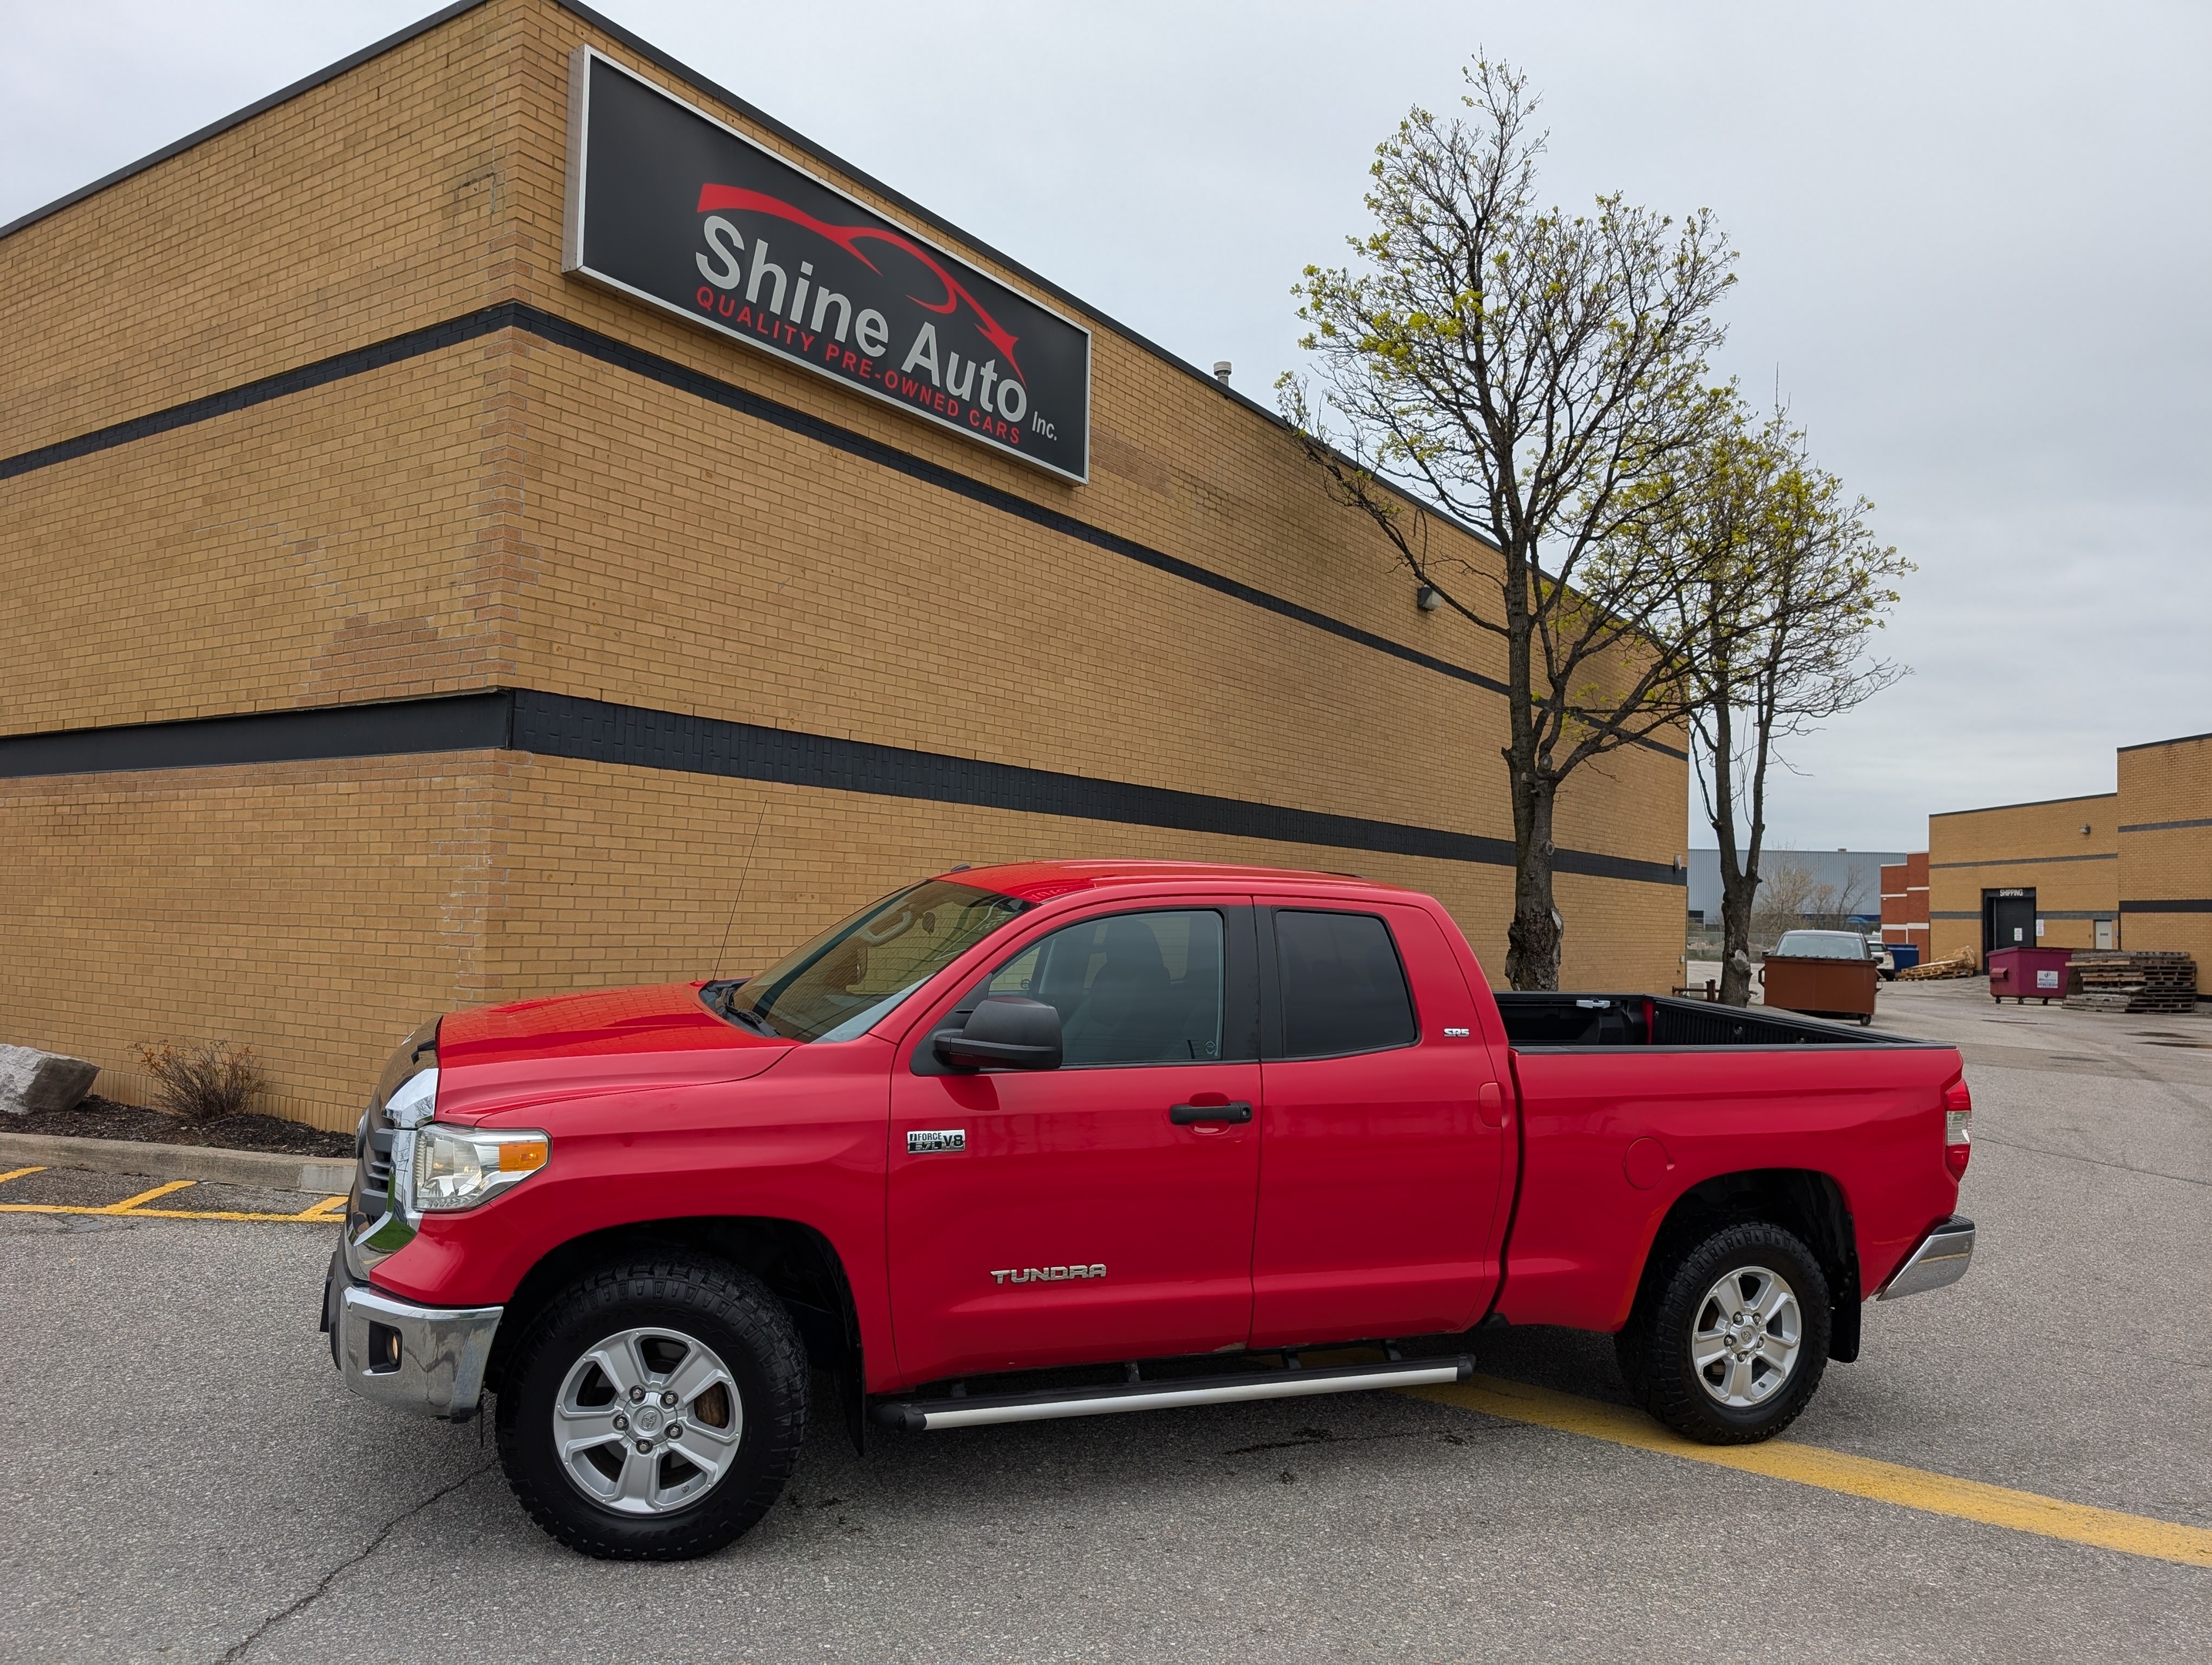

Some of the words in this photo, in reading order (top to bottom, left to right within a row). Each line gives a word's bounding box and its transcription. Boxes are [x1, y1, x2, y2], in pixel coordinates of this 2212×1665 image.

[695, 215, 889, 358] Shine
[901, 321, 1027, 422] Auto
[1032, 411, 1057, 441] Inc.
[696, 286, 815, 352] QUALITY
[825, 343, 959, 417] PRE-OWNED
[969, 409, 1020, 444] CARS
[1999, 889, 2023, 897] SHIPPING
[1444, 1028, 1470, 1037] SR5
[915, 1142, 939, 1150] 5.7L
[943, 1135, 964, 1148] V8
[991, 1263, 1106, 1284] TUNDRA
